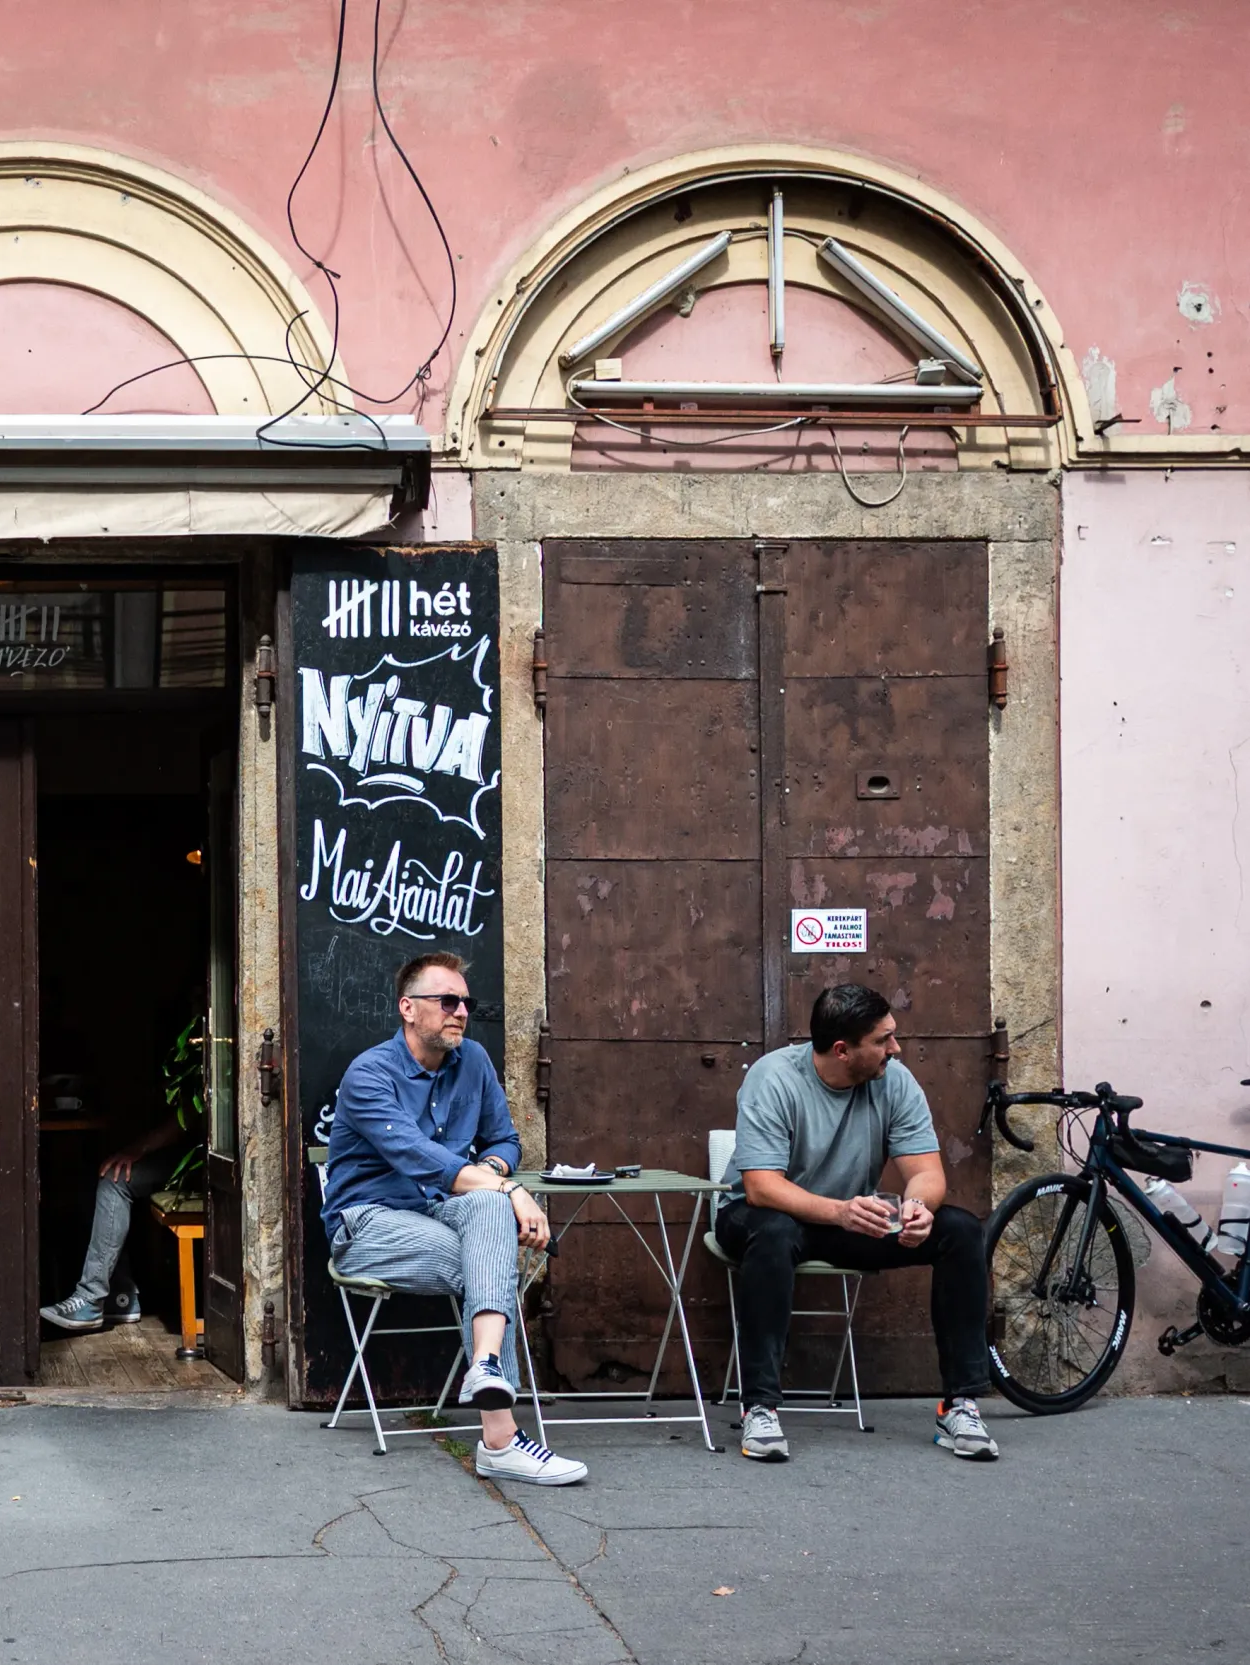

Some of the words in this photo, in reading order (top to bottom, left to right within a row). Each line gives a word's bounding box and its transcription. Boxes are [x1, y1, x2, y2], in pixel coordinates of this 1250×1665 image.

[409, 580, 472, 617] hét
[409, 619, 472, 637] kávézó
[300, 819, 374, 910] Mai
[1036, 1184, 1065, 1198] MAVIC
[1112, 1309, 1128, 1351] MAVIC
[989, 1345, 1011, 1379] MAVIC
